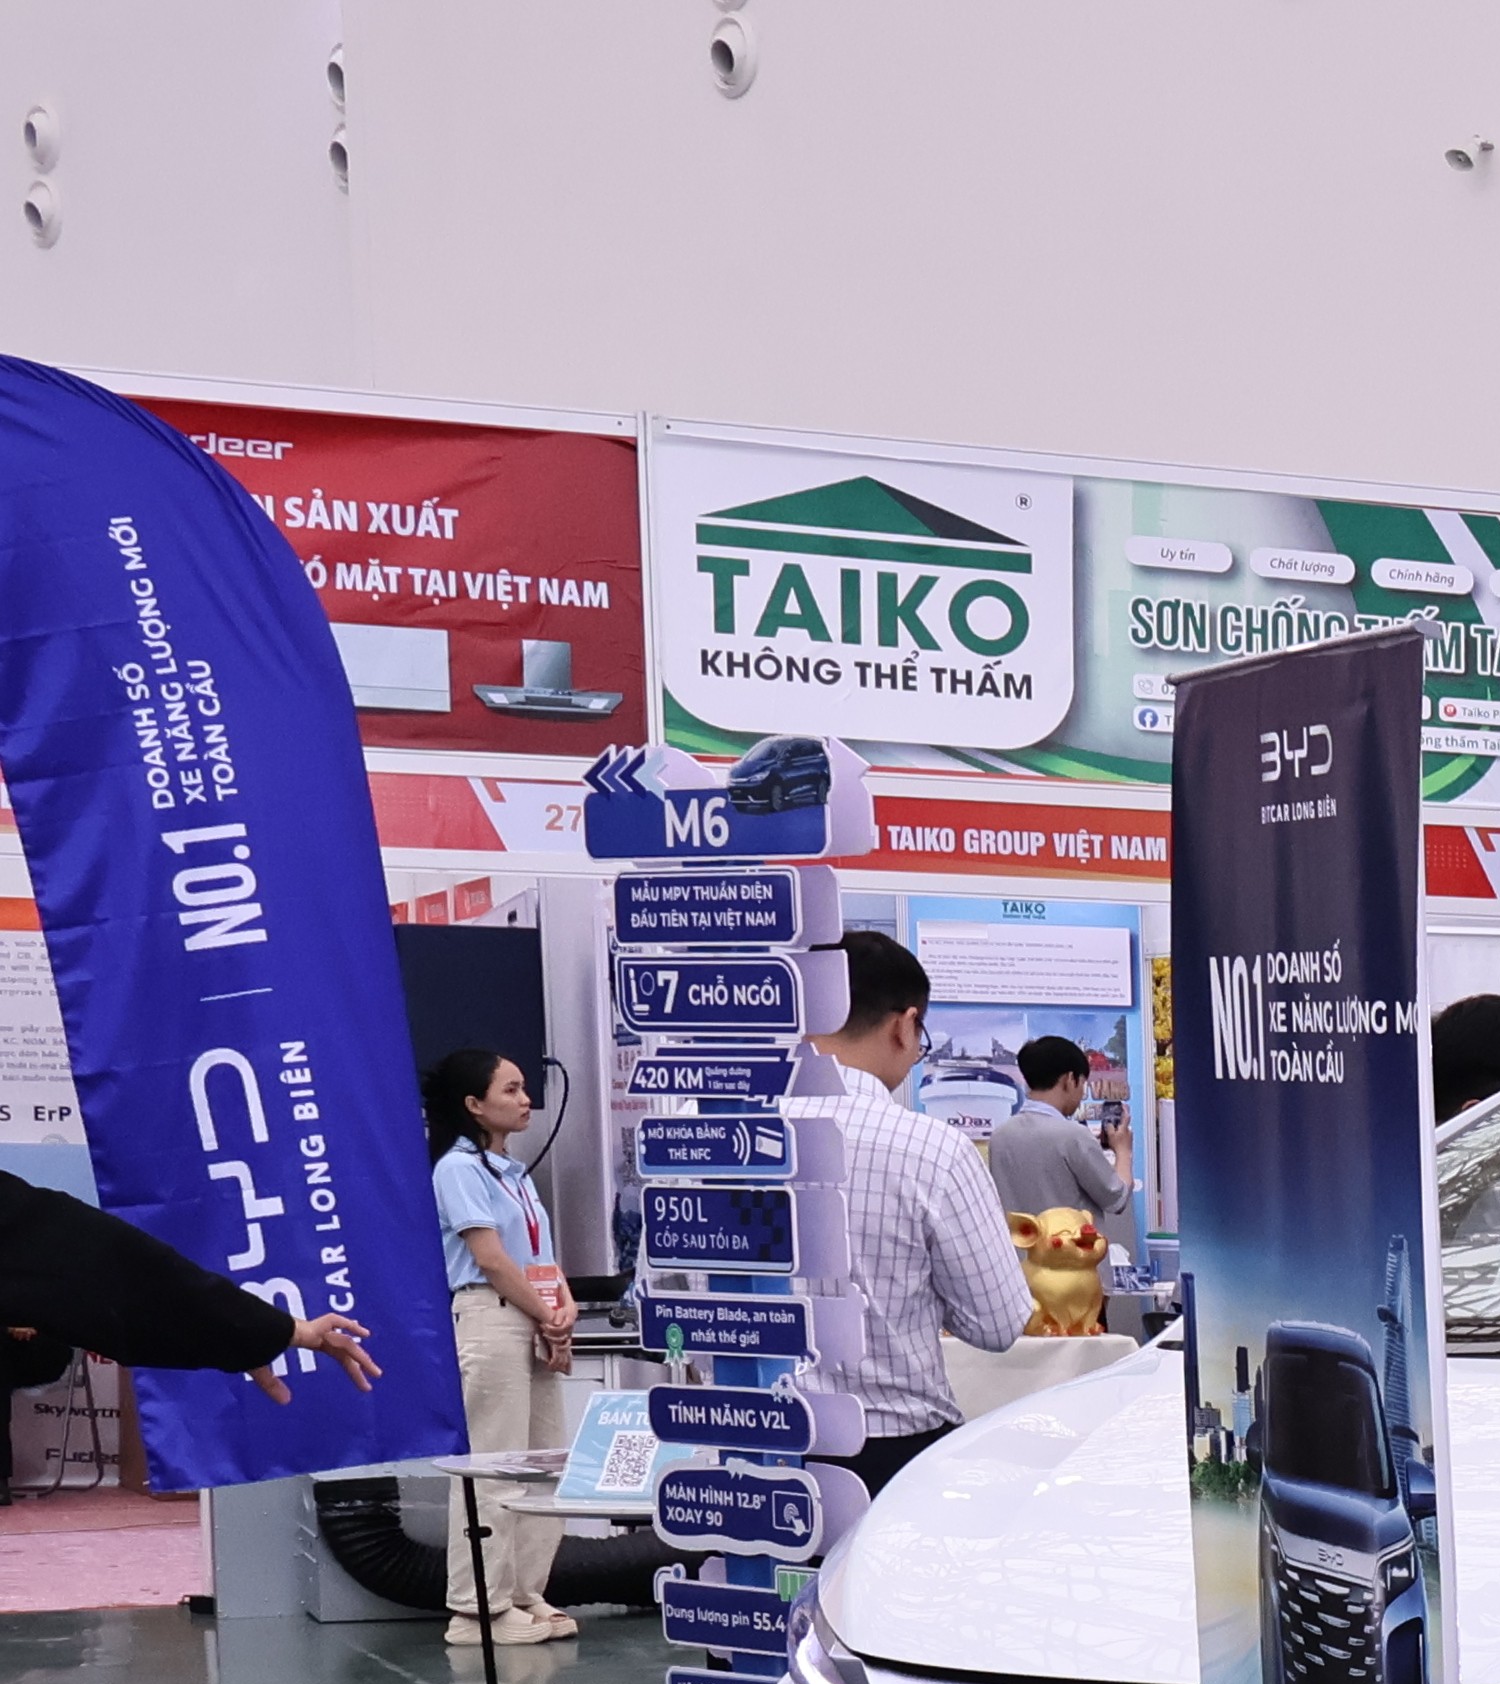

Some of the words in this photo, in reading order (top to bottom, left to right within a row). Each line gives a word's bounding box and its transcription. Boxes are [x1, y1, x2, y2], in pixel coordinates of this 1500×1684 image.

[285, 489, 358, 531] SẢN
[367, 497, 458, 540] XUẤT
[109, 515, 148, 571] MỚI
[335, 562, 401, 601] MẶT
[408, 567, 457, 605] TẠI
[463, 569, 530, 610] VIỆT
[539, 578, 610, 609] NAM
[1269, 556, 1298, 572] Chất
[1299, 559, 1336, 576] lượng
[1388, 567, 1421, 583] Chính
[1423, 571, 1455, 587] hãng
[130, 578, 178, 675] LƯỢNG
[697, 555, 1030, 657] TAIKO
[1129, 596, 1208, 650] SƠN
[113, 662, 150, 700] SỐ
[187, 660, 222, 718] CẦU
[700, 647, 842, 685] KHÔNG
[854, 651, 919, 692] THỂ
[930, 661, 1032, 700] THẤM
[162, 681, 199, 762] NĂNG
[1461, 707, 1490, 719] Taiko
[134, 707, 175, 810] DOANH
[204, 723, 238, 801] TOÀN
[1260, 725, 1332, 783] BYD
[181, 769, 208, 804] XE
[1291, 801, 1315, 822] LONG
[1317, 794, 1337, 819] BIÊN
[664, 797, 730, 848] M6
[887, 825, 955, 852] TAIKO
[963, 829, 1045, 857] GROUP
[1053, 829, 1104, 864] VIỆT
[1110, 835, 1167, 862] NAM
[161, 823, 267, 950] NO.1
[631, 881, 660, 902] MẪU
[662, 886, 690, 901] MPV
[693, 882, 738, 902] THUẦN
[740, 882, 774, 905] ĐIỆN
[1002, 901, 1046, 914] TAIKO
[630, 908, 658, 928] ĐẦU
[659, 908, 688, 928] TIÊN
[690, 911, 712, 932] TẠI
[715, 907, 743, 930] VIỆT
[745, 911, 777, 927] NAM
[1267, 951, 1320, 984] DOANH
[1323, 939, 1341, 983] SỐ
[656, 970, 680, 1014] 7
[688, 974, 729, 1007] CHỖ
[732, 976, 781, 1007] NGỒI
[1209, 954, 1265, 1080] NO.1
[280, 1040, 319, 1121] BIÊN
[634, 1068, 668, 1090] 420
[674, 1068, 704, 1090] KM
[1270, 1041, 1313, 1082] TOÀN
[1316, 1040, 1344, 1083] CẦU
[33, 1105, 72, 1121] ErP
[300, 1133, 341, 1232] LONG
[655, 1226, 679, 1249] CỐP
[682, 1232, 706, 1249] SAU
[708, 1226, 730, 1250] TỐI
[731, 1234, 750, 1250] ĐA
[668, 1401, 706, 1424] TÍNH
[710, 1404, 757, 1428] NĂNG
[760, 1412, 790, 1429] V2L
[665, 1482, 696, 1501] MÀN
[700, 1485, 734, 1506] HÌNH
[665, 1506, 703, 1524] XOAY
[706, 1510, 723, 1526] 90
